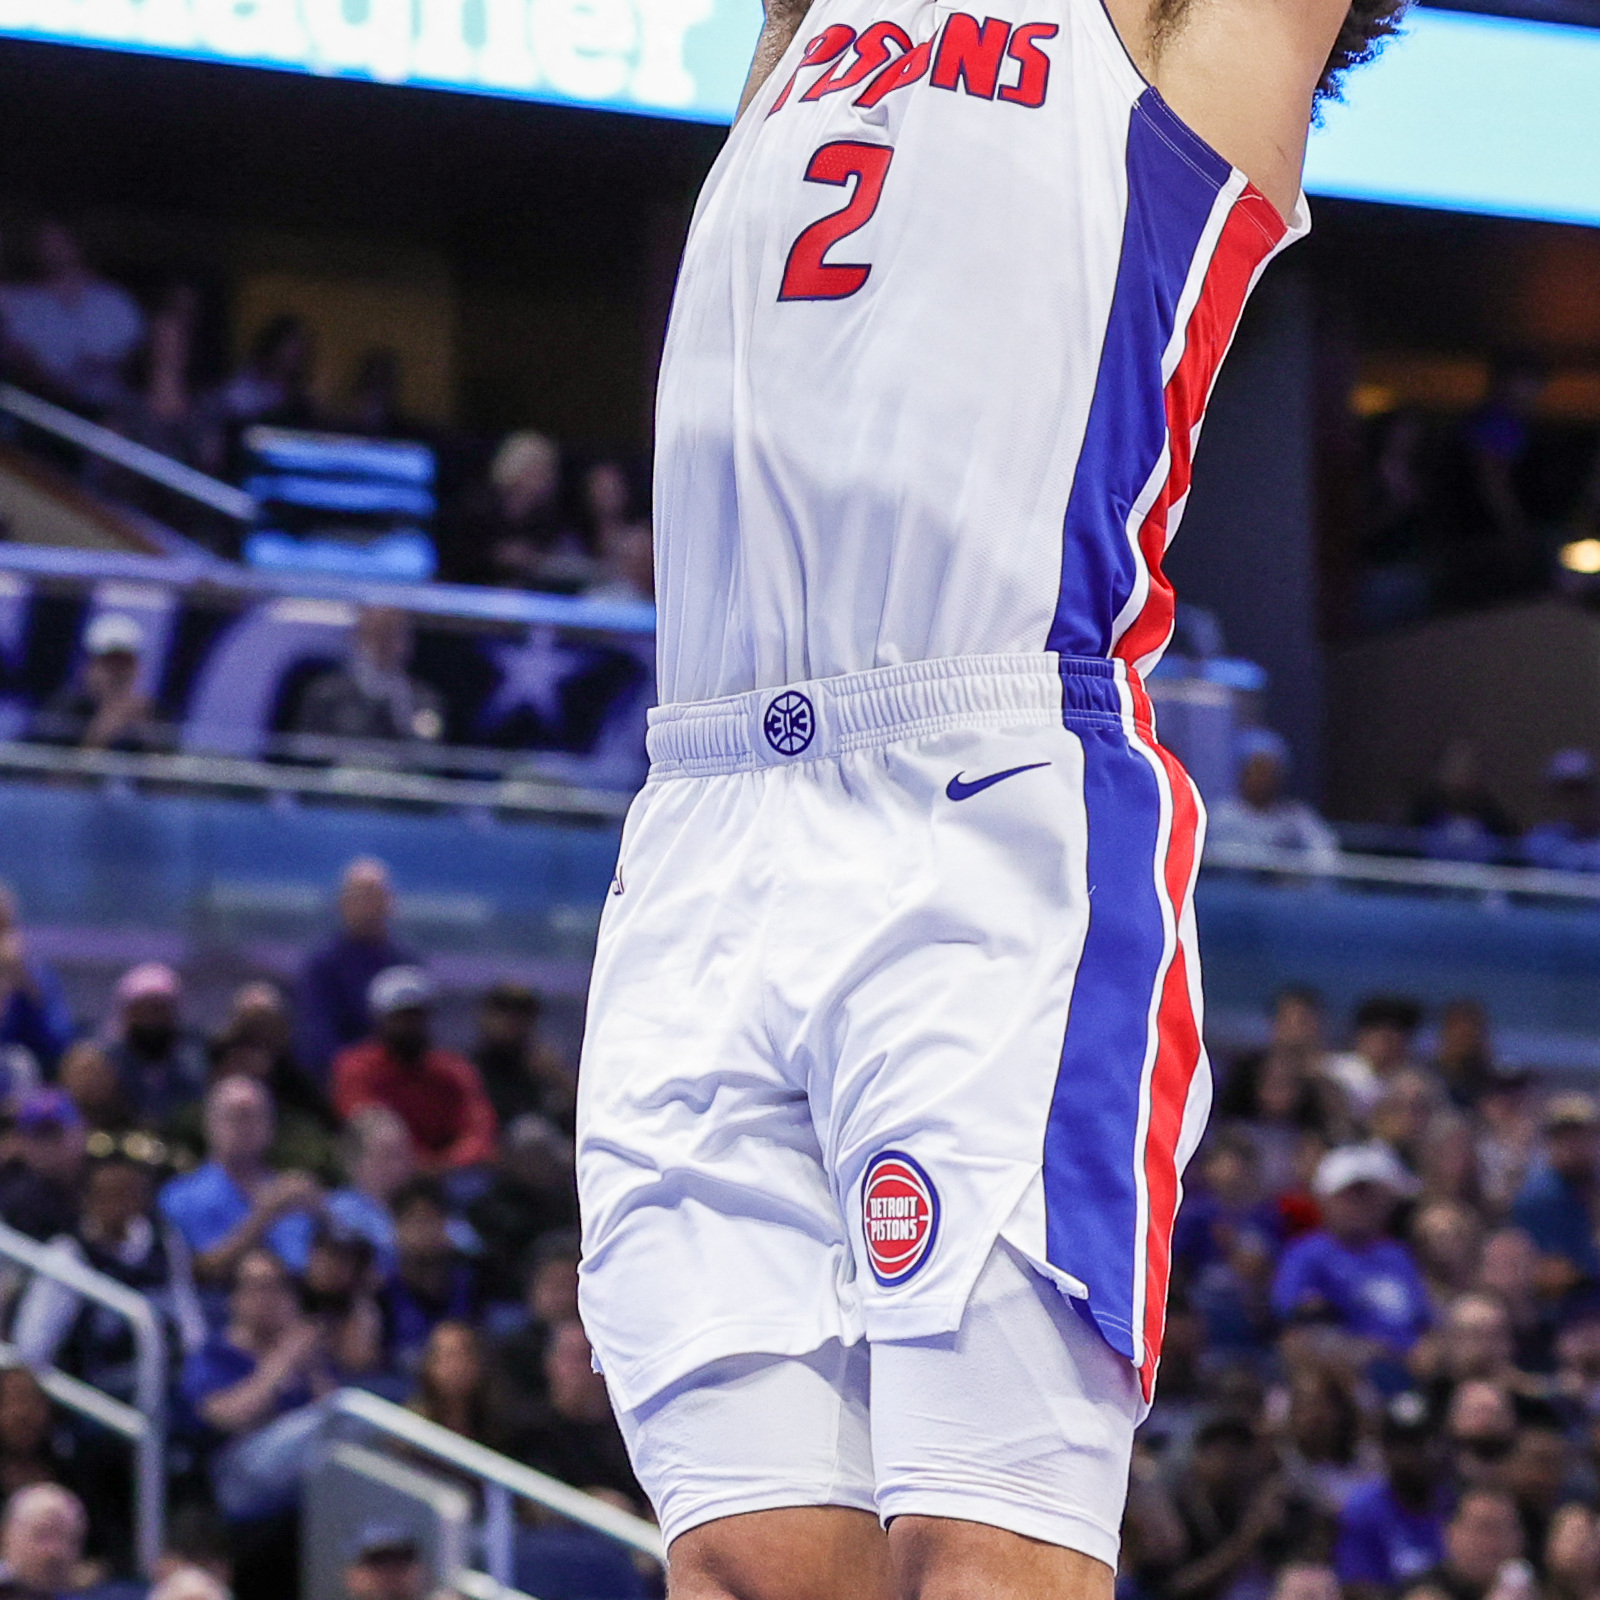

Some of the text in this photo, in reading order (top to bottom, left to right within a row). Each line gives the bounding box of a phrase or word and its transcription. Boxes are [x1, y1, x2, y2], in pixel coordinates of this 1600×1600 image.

[776, 139, 895, 303] 2
[869, 1196, 919, 1219] DETROIT
[870, 1218, 919, 1242] PISTONS
